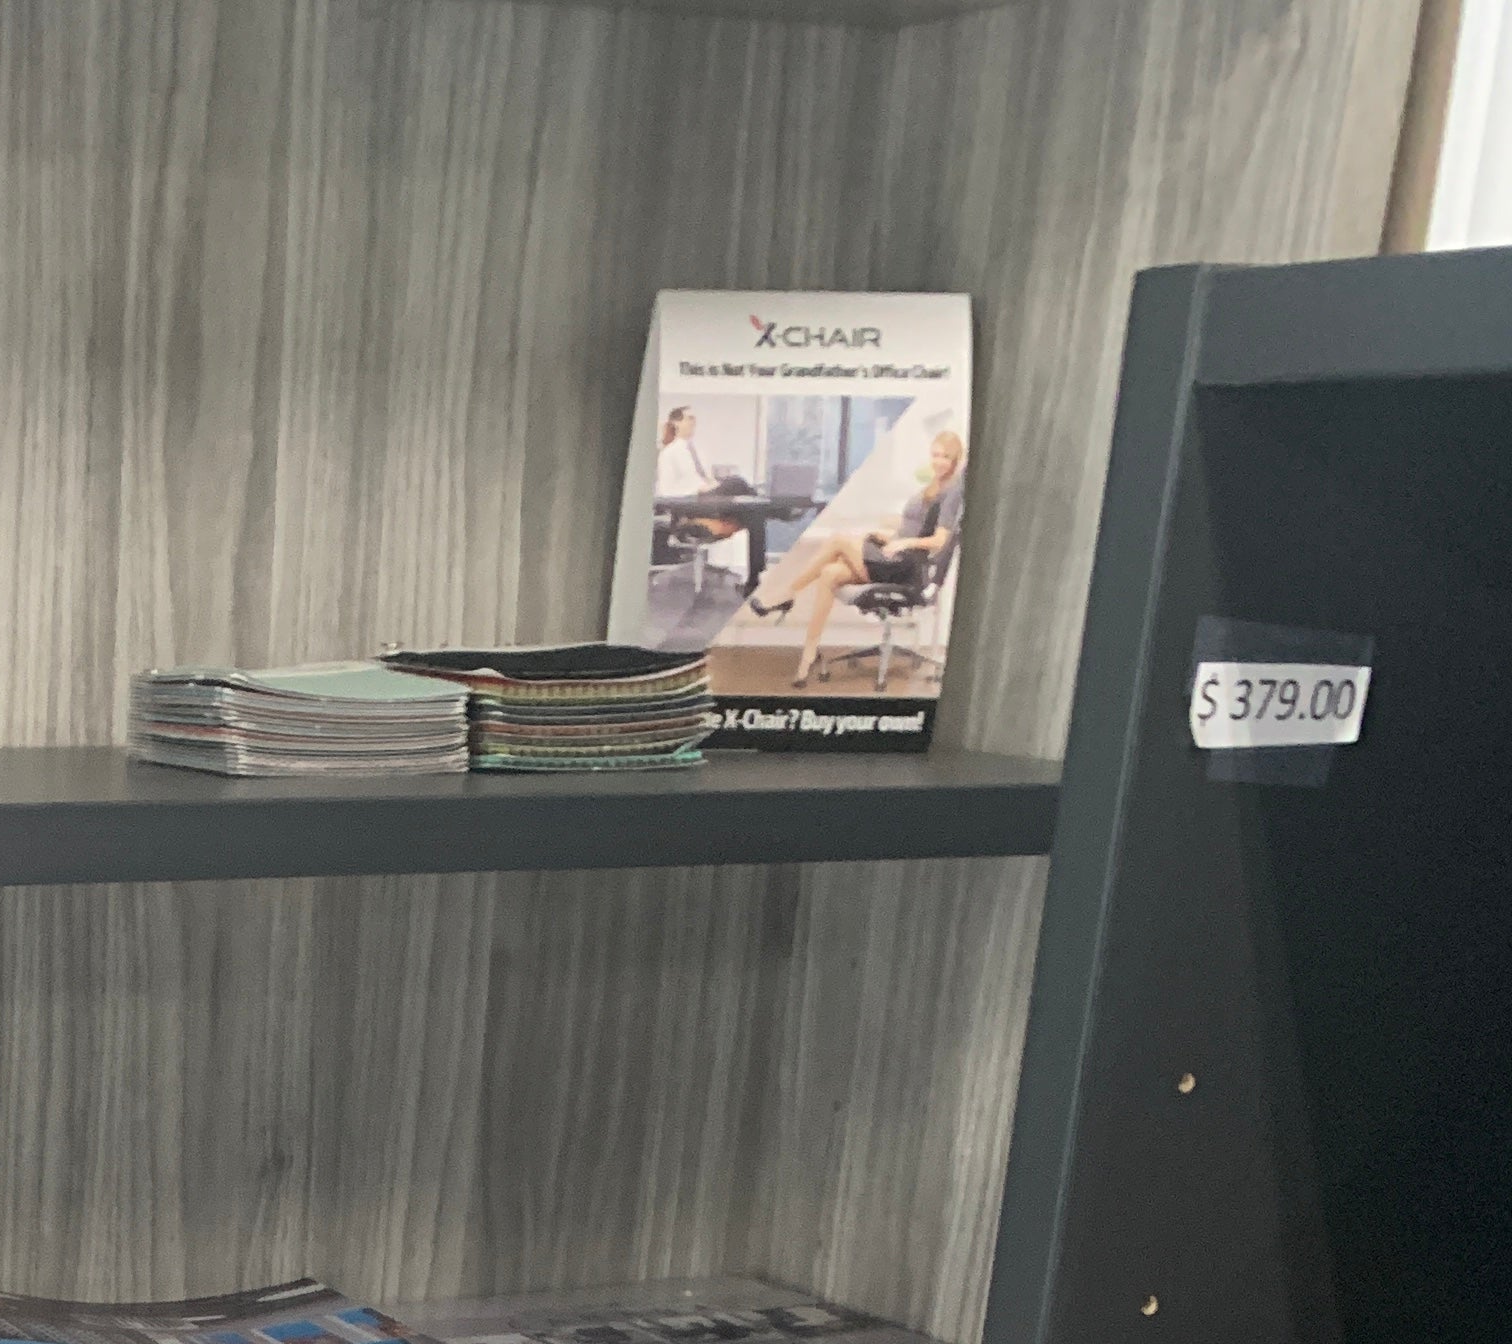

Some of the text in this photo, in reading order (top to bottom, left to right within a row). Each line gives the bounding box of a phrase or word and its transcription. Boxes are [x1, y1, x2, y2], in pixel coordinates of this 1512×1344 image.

[750, 315, 881, 348] X-CHAIR
[1229, 678, 1356, 721] 379.00
[800, 709, 836, 736] Buy
